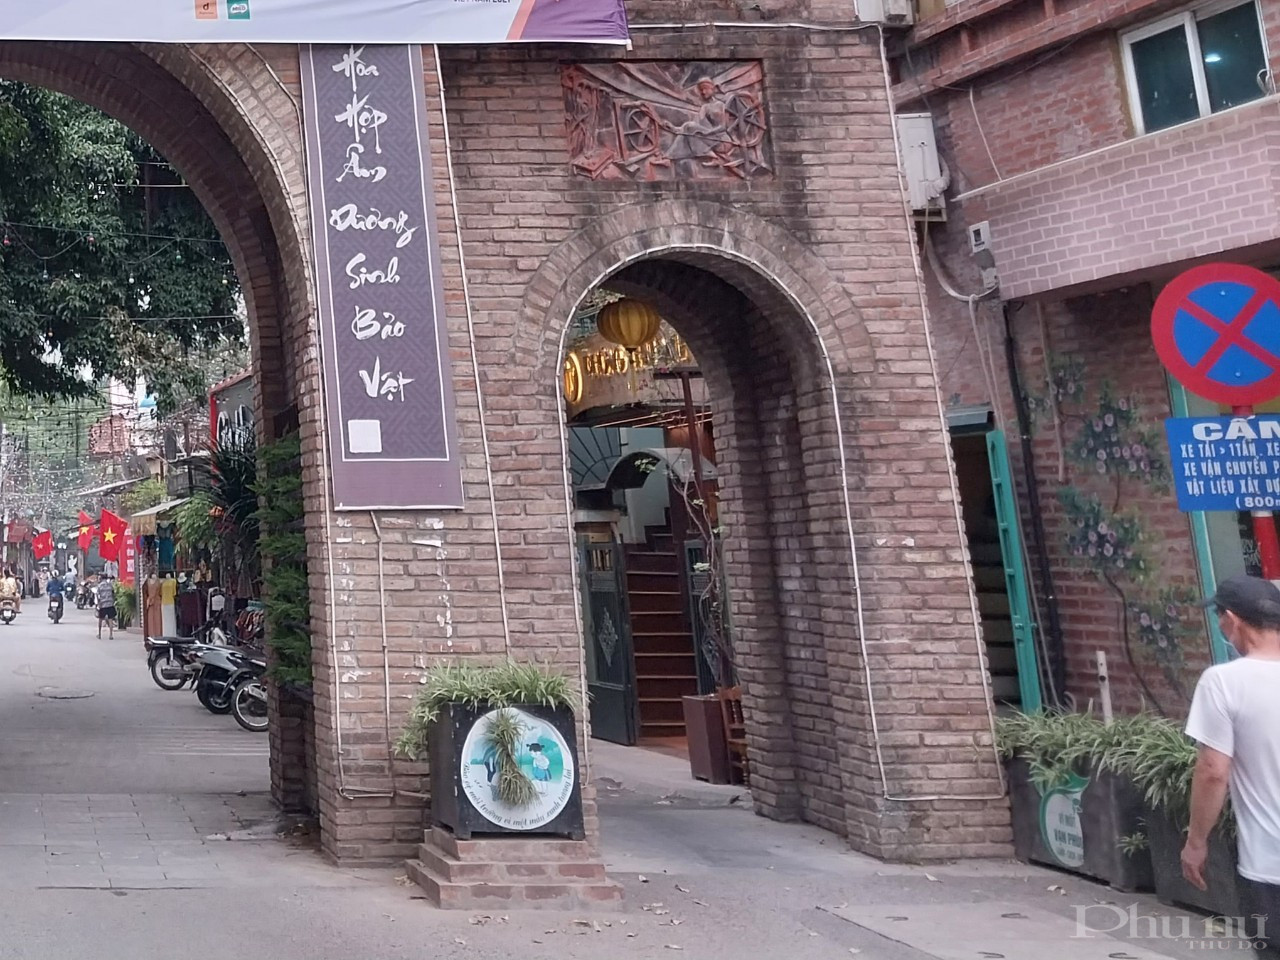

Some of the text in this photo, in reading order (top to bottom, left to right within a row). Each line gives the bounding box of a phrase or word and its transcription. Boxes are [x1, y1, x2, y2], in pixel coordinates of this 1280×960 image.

[346, 253, 400, 289] Sinh
[351, 305, 407, 340] Bảo
[359, 355, 415, 402] Vật
[1181, 444, 1194, 457] XE
[1198, 440, 1215, 457] TẢI
[1183, 462, 1197, 476] XE
[1201, 459, 1221, 478] VẬN
[1226, 455, 1267, 475] CHUYỂN
[1186, 478, 1204, 496] VẬT
[1210, 477, 1234, 496] LIỆU
